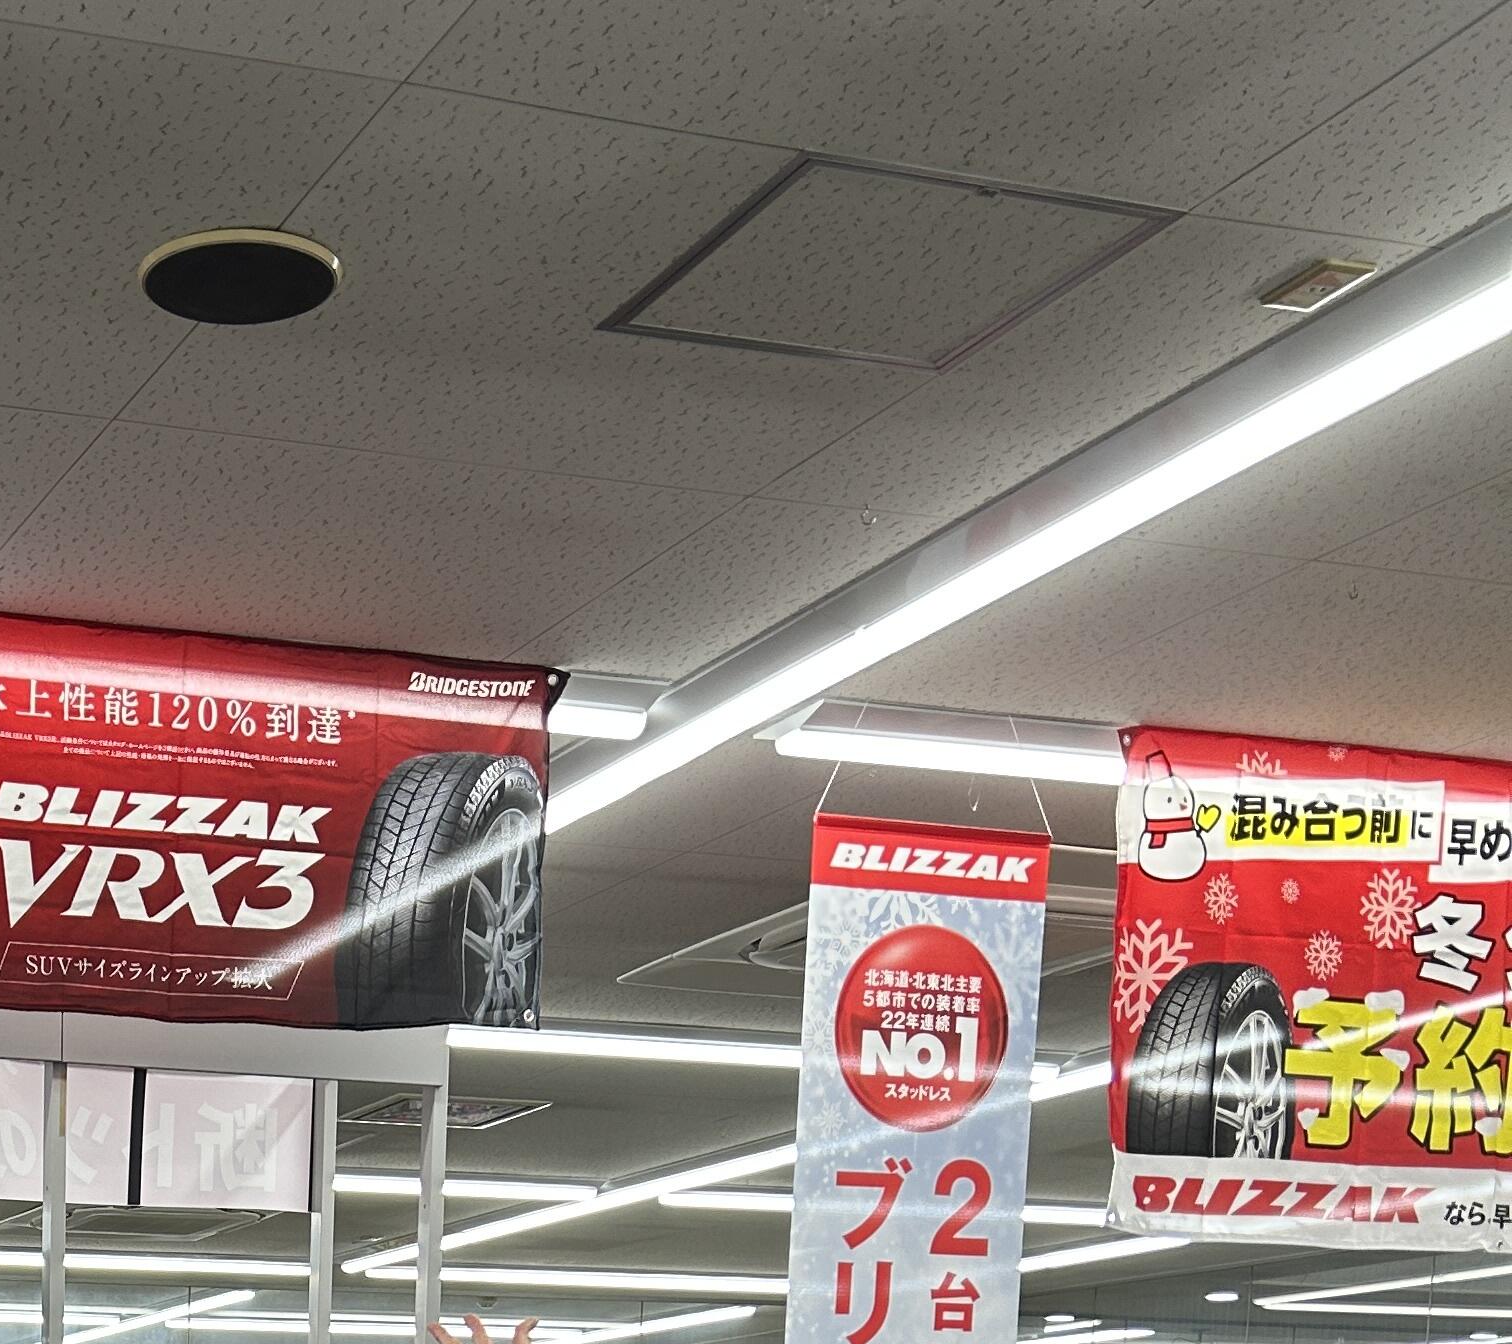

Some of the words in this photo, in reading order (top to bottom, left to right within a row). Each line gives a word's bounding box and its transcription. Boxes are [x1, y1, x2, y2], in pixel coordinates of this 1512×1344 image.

[408, 671, 535, 698] BRIDGESTONE
[1229, 790, 1433, 844] 混み合う前に
[830, 842, 1038, 885] BLIZZAK
[25, 952, 273, 991] SUVサイズラインアップ拡大
[864, 968, 982, 994] 北海道・北東北主要
[863, 990, 981, 1015] 5都市での装着率
[880, 1010, 951, 1033] 22年連続
[860, 1016, 979, 1083] NO.1
[884, 1083, 952, 1102] スタッドレス
[1133, 1175, 1436, 1225] BLIZZAK
